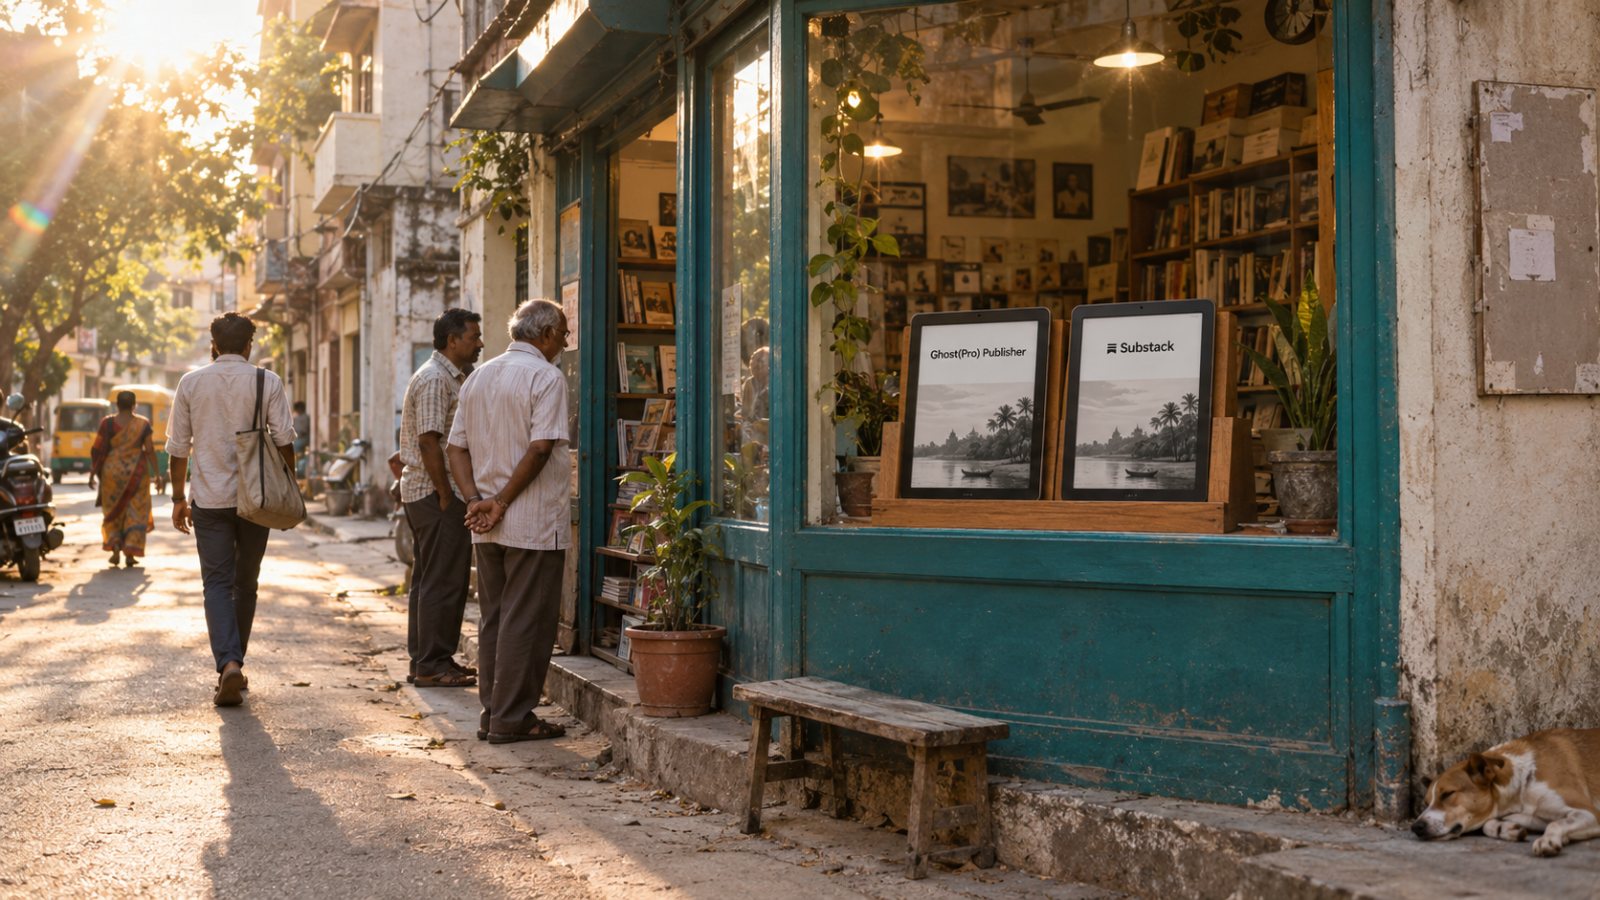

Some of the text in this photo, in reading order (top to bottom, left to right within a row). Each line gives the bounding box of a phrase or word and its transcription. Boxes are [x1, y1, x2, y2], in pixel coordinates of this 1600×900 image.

[1120, 340, 1174, 353] Substack
[930, 347, 1027, 360] Ghost(Pro) Publisher
